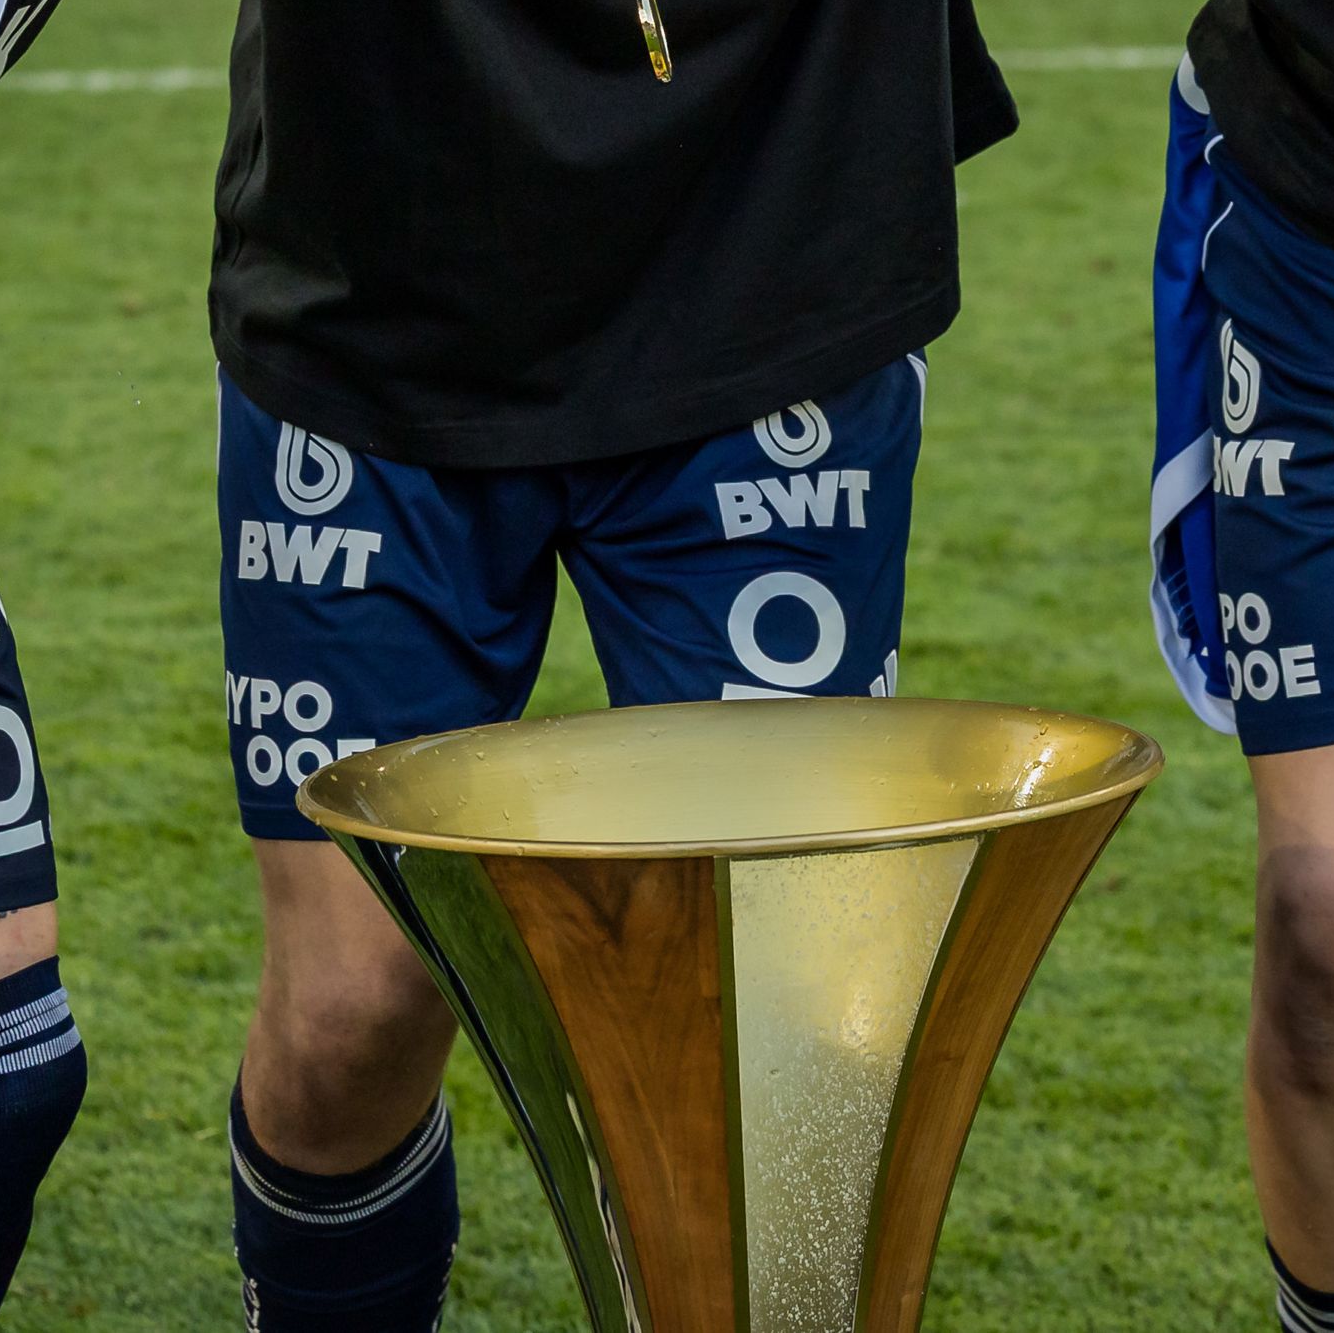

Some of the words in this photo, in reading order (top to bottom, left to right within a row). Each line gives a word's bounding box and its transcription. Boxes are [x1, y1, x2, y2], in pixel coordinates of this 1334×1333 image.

[715, 469, 871, 540] BWT
[238, 519, 382, 589] BWT
[1219, 592, 1272, 645] PO
